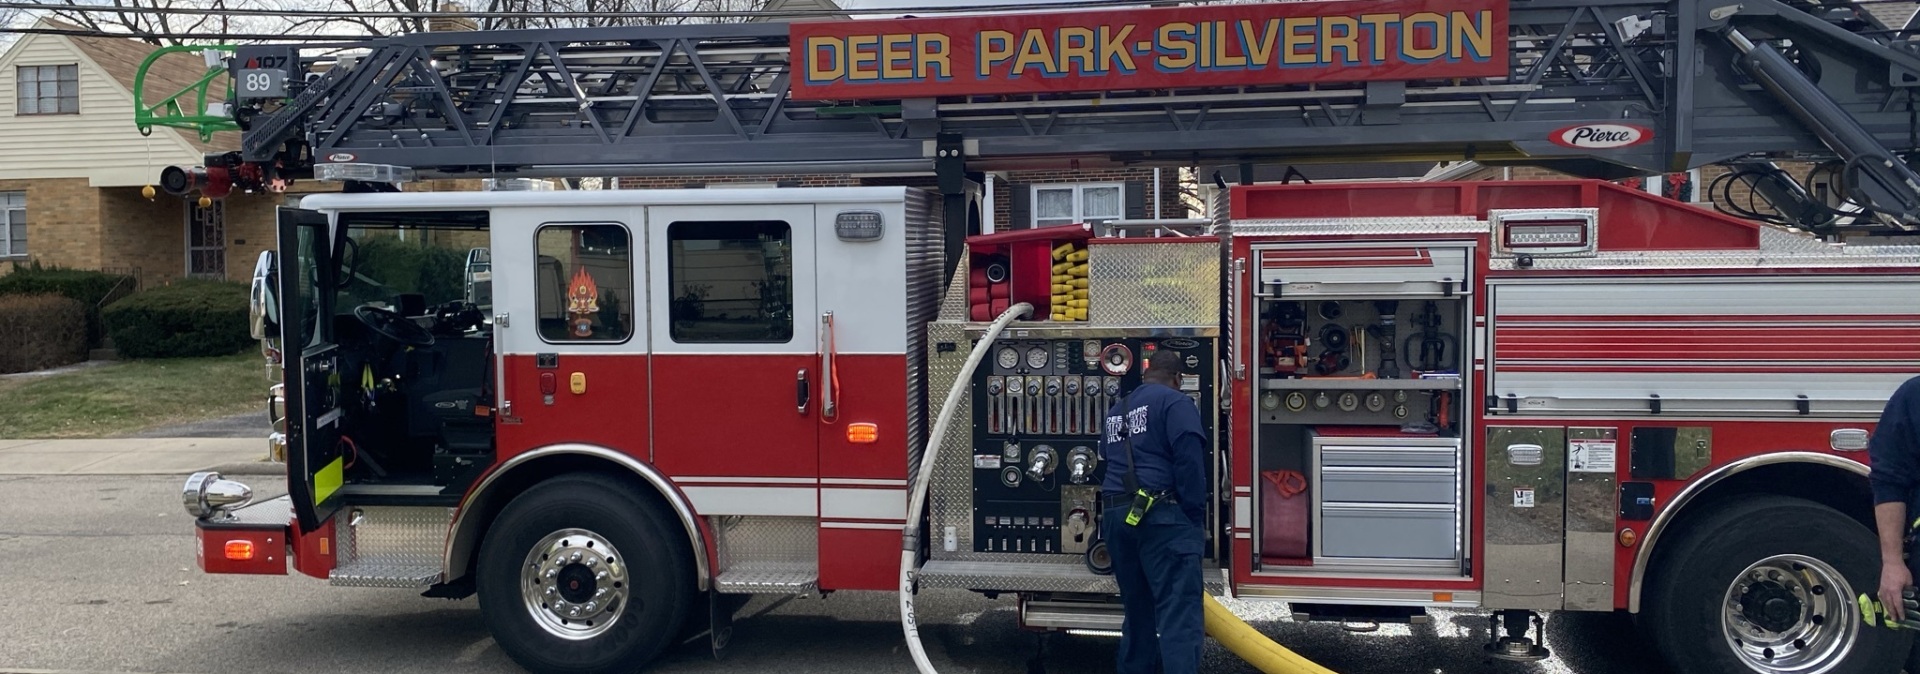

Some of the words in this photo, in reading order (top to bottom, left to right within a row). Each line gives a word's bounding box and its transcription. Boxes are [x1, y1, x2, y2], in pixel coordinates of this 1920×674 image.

[805, 32, 953, 85] DEER
[976, 10, 1493, 80] PARK-SILVERTON
[246, 73, 271, 91] 89
[1571, 127, 1631, 145] Pierce
[1106, 414, 1128, 424] DEE
[1107, 425, 1147, 444] SILVTON
